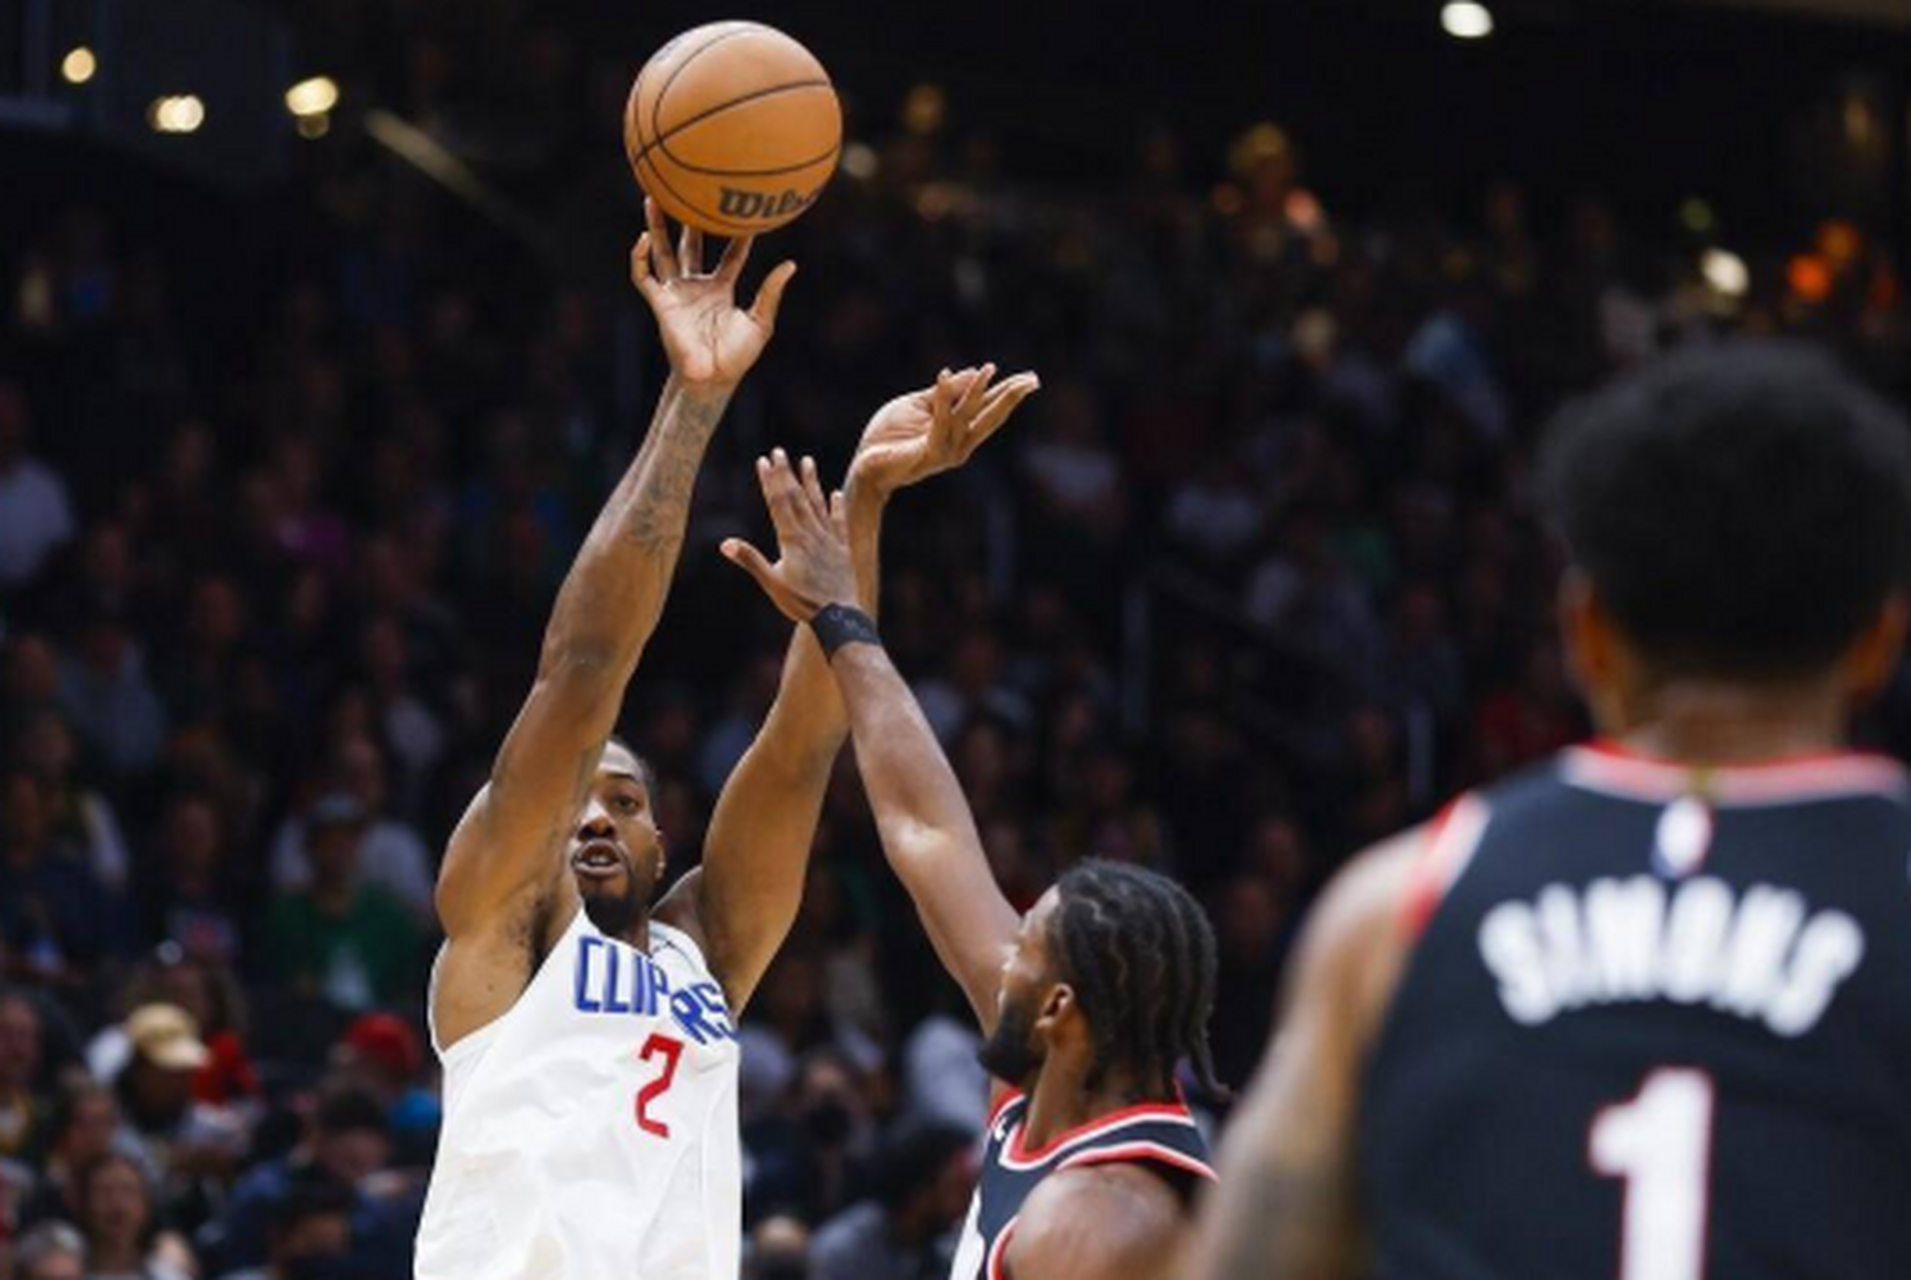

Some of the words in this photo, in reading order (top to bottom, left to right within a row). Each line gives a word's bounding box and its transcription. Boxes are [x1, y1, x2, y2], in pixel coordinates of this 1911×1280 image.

[1478, 873, 1866, 1038] SIMONS
[635, 1031, 684, 1138] 2
[1588, 1064, 1715, 1279] 1
